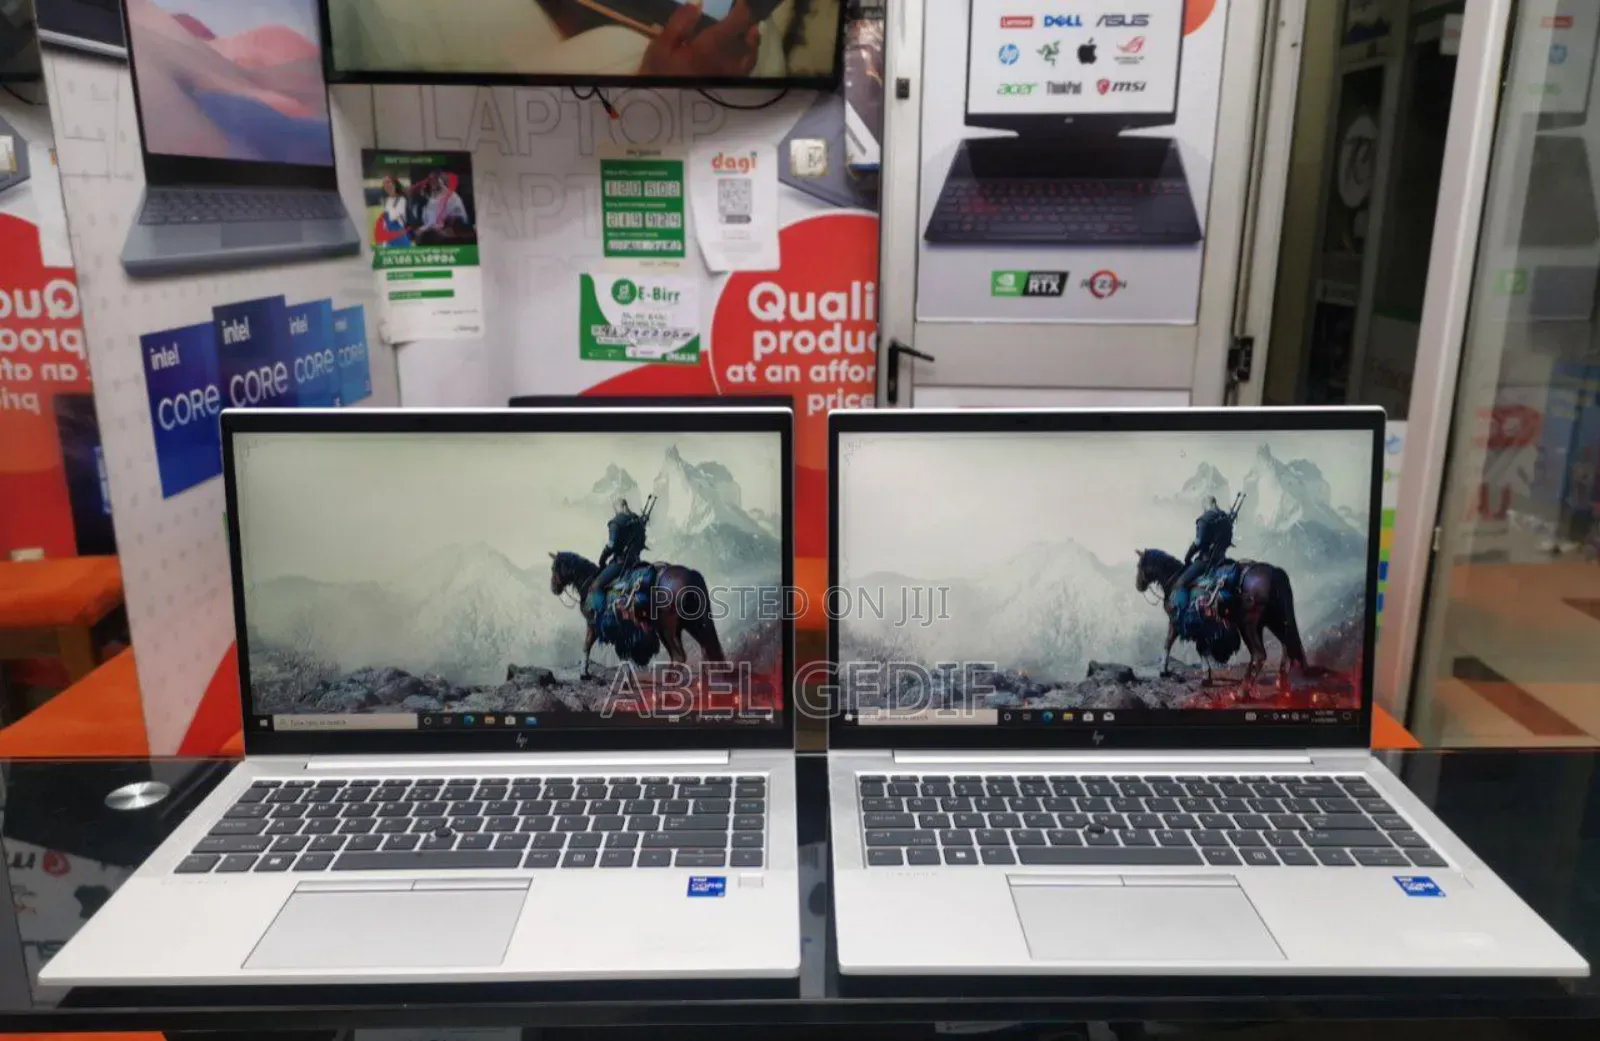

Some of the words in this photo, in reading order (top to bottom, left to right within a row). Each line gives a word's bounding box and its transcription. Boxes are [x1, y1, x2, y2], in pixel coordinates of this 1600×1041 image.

[1044, 15, 1083, 27] DELL
[1096, 14, 1149, 27] ASUS
[997, 83, 1038, 95] acer
[1111, 81, 1146, 92] msi
[711, 152, 757, 174] dagi
[638, 286, 681, 302] E-Birr
[1028, 280, 1060, 293] RTX
[748, 280, 875, 322] Quali
[221, 315, 250, 345] intel
[289, 314, 308, 335] intel
[151, 342, 180, 371] intel
[725, 362, 757, 383] at
[764, 365, 800, 383] an
